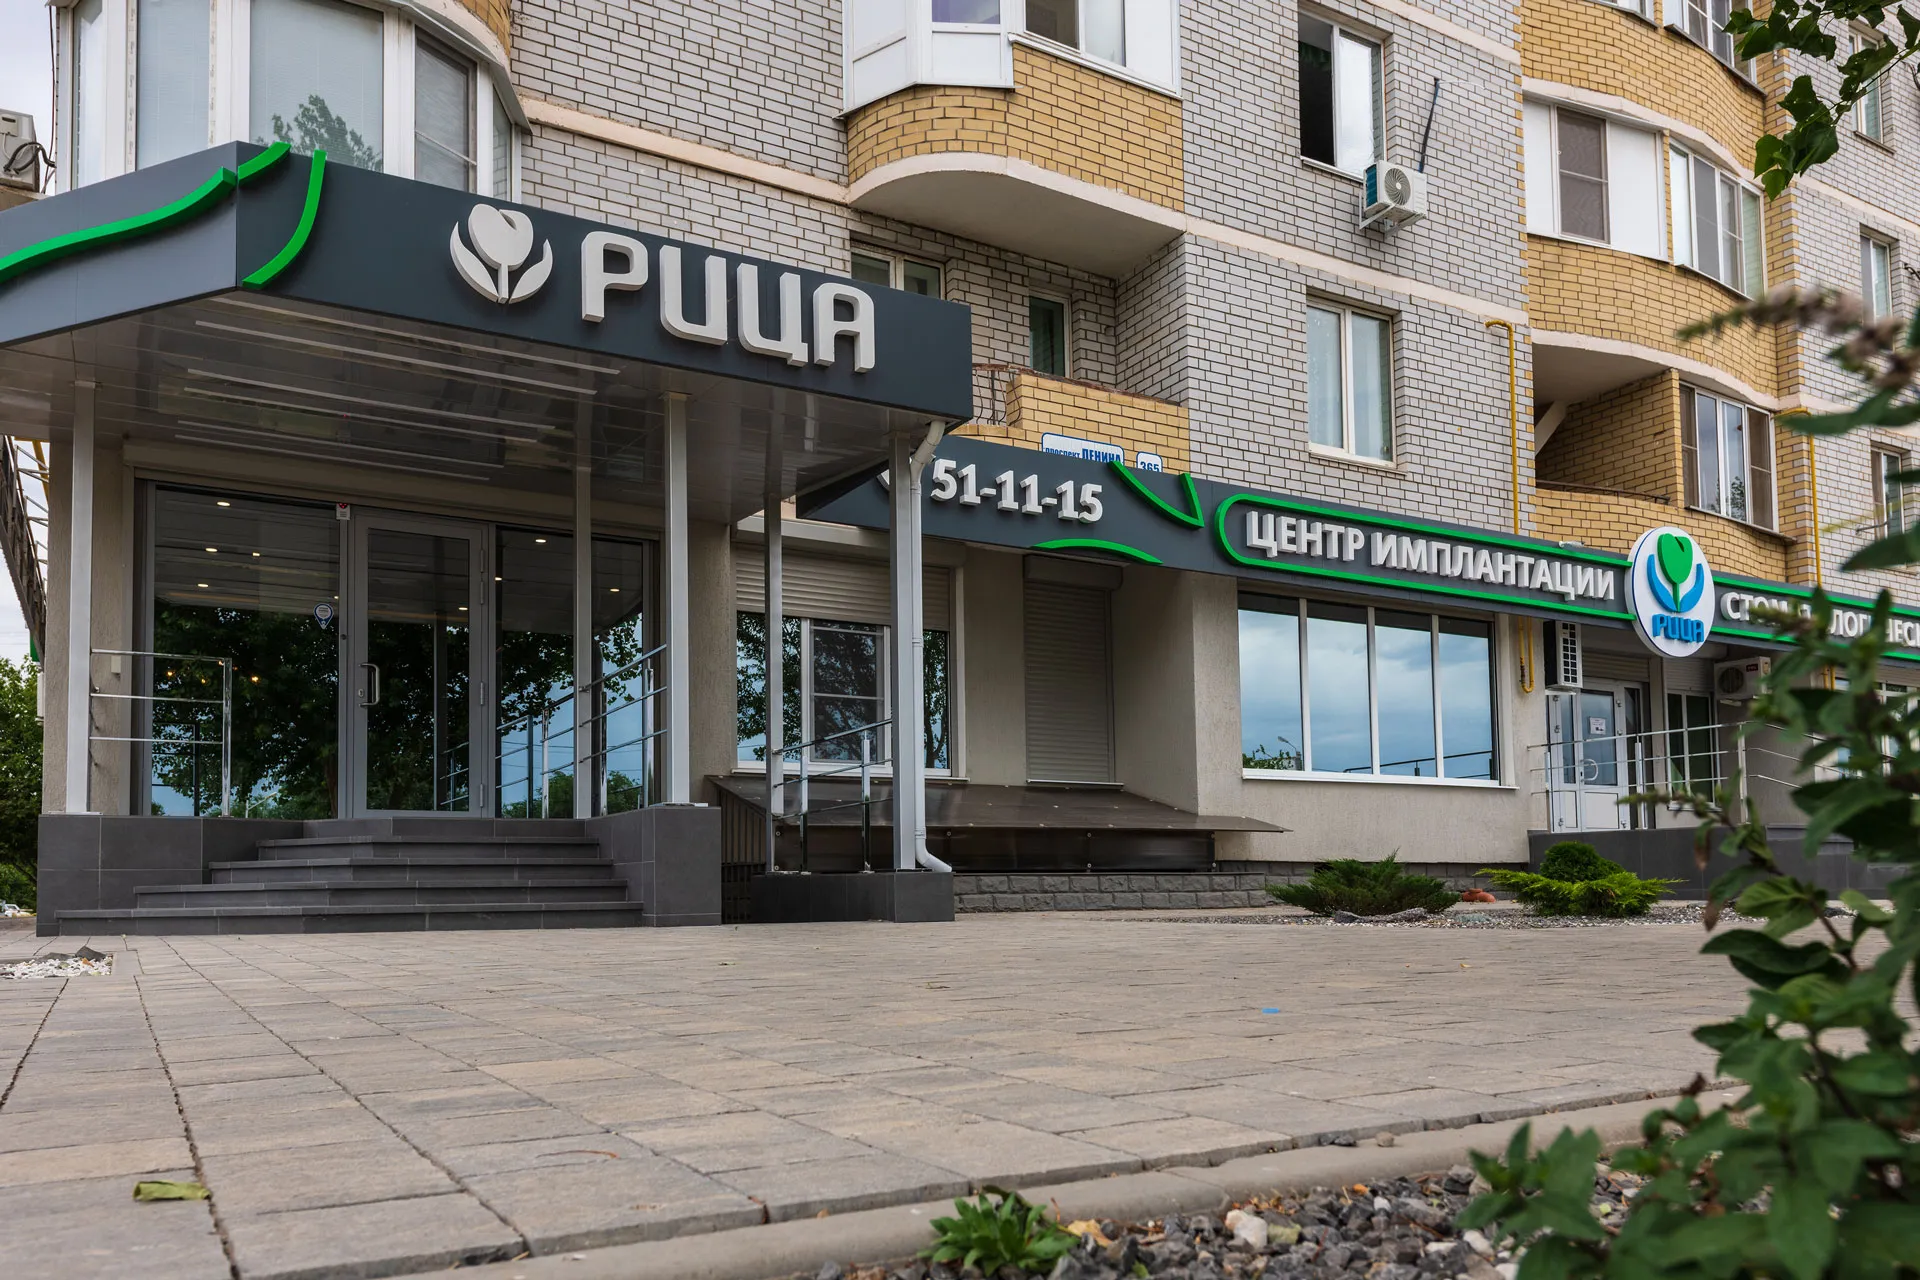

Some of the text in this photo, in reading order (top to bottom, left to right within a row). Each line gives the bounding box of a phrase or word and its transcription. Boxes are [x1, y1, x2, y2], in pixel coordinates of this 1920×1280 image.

[581, 231, 875, 373] РИЦА
[931, 458, 1103, 524] 51-11-15
[1246, 510, 1615, 600] ЦЕНТР ИМПЛАНТАЦИИ
[1652, 613, 1704, 643] РИЦА
